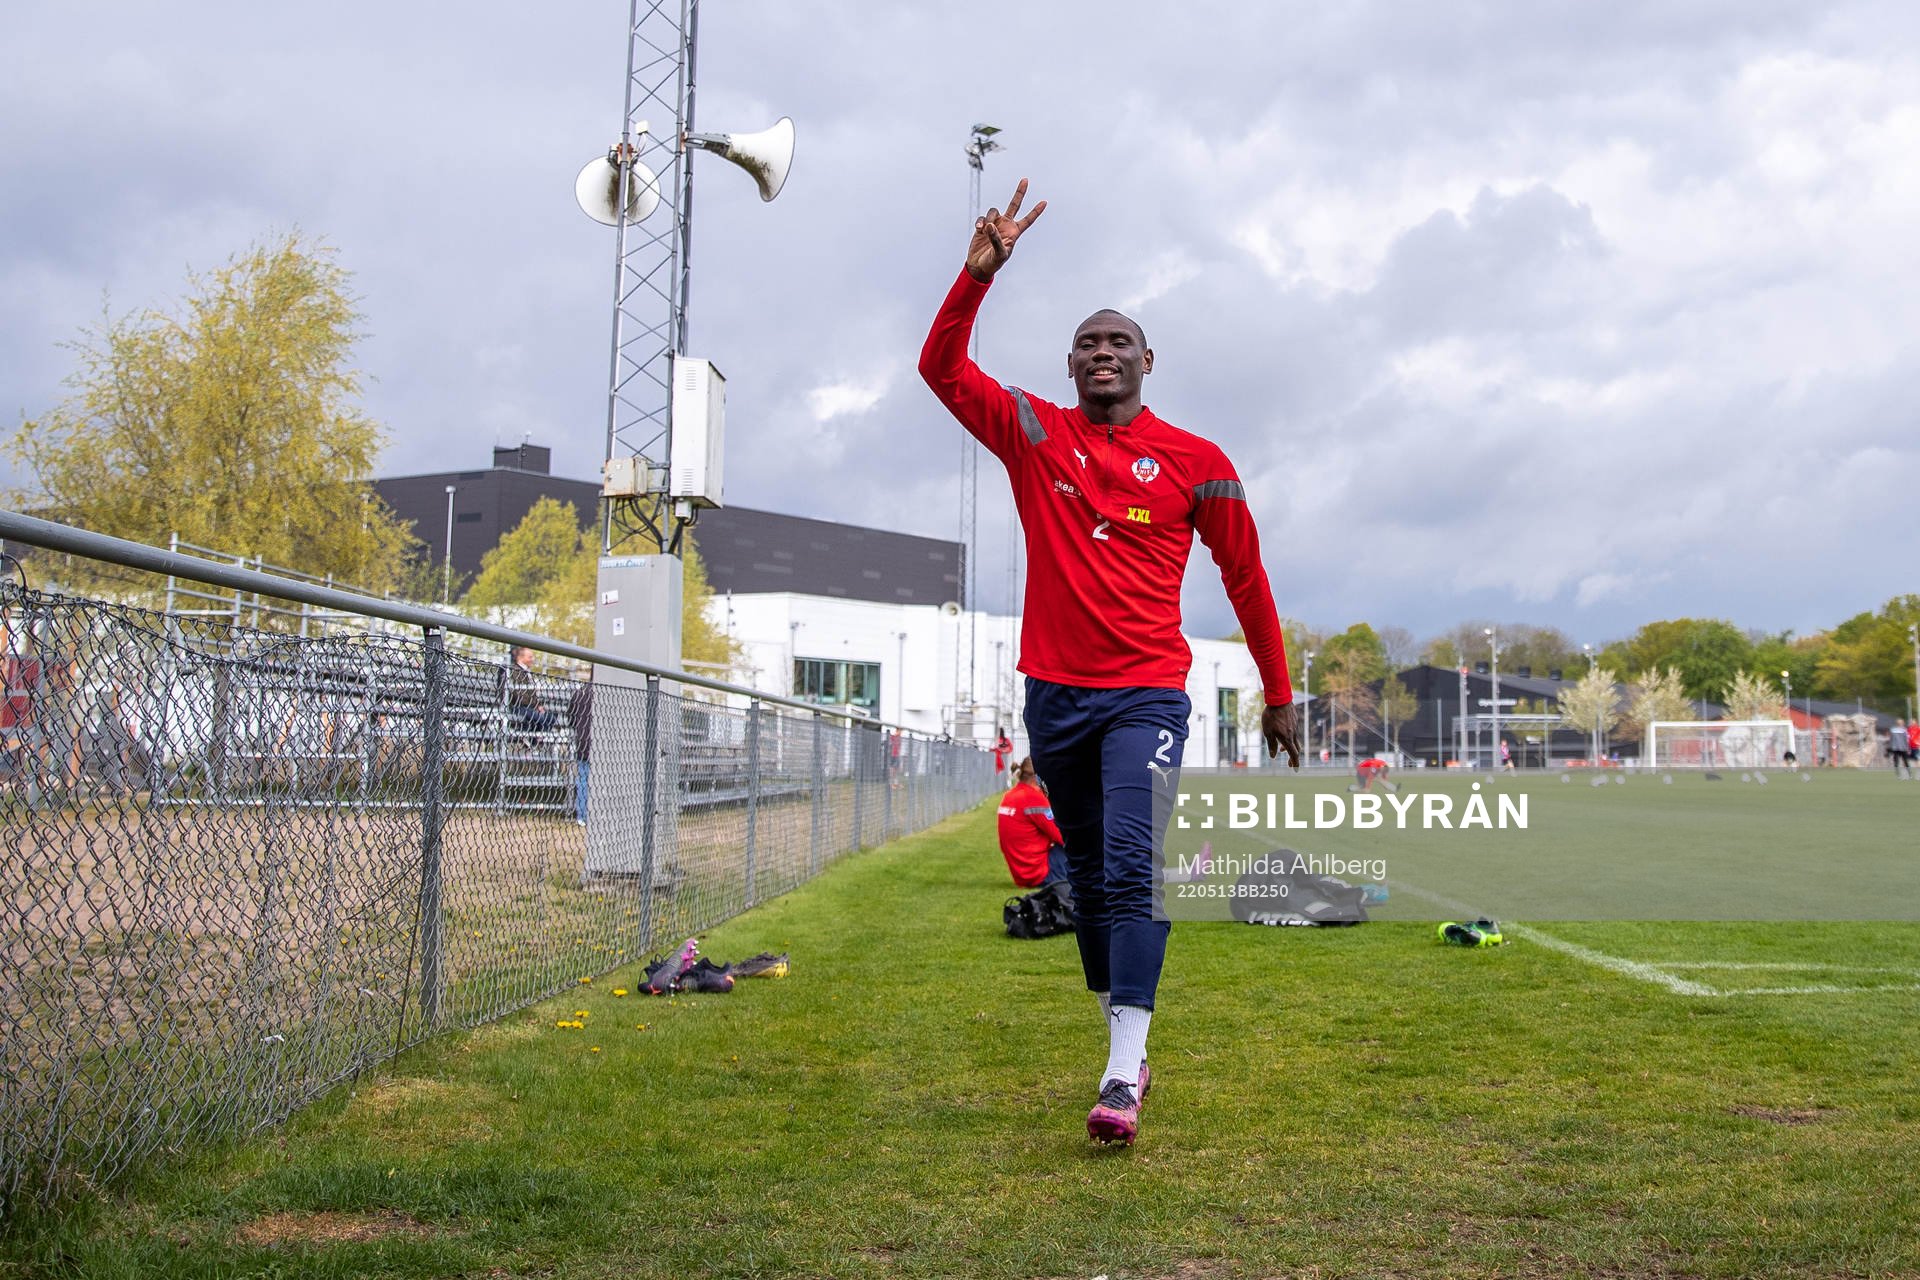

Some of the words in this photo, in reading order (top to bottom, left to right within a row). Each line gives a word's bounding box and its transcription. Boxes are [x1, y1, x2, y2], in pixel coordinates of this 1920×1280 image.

[1092, 513, 1109, 540] 2
[1126, 507, 1151, 523] XXL
[1155, 729, 1174, 763] 2
